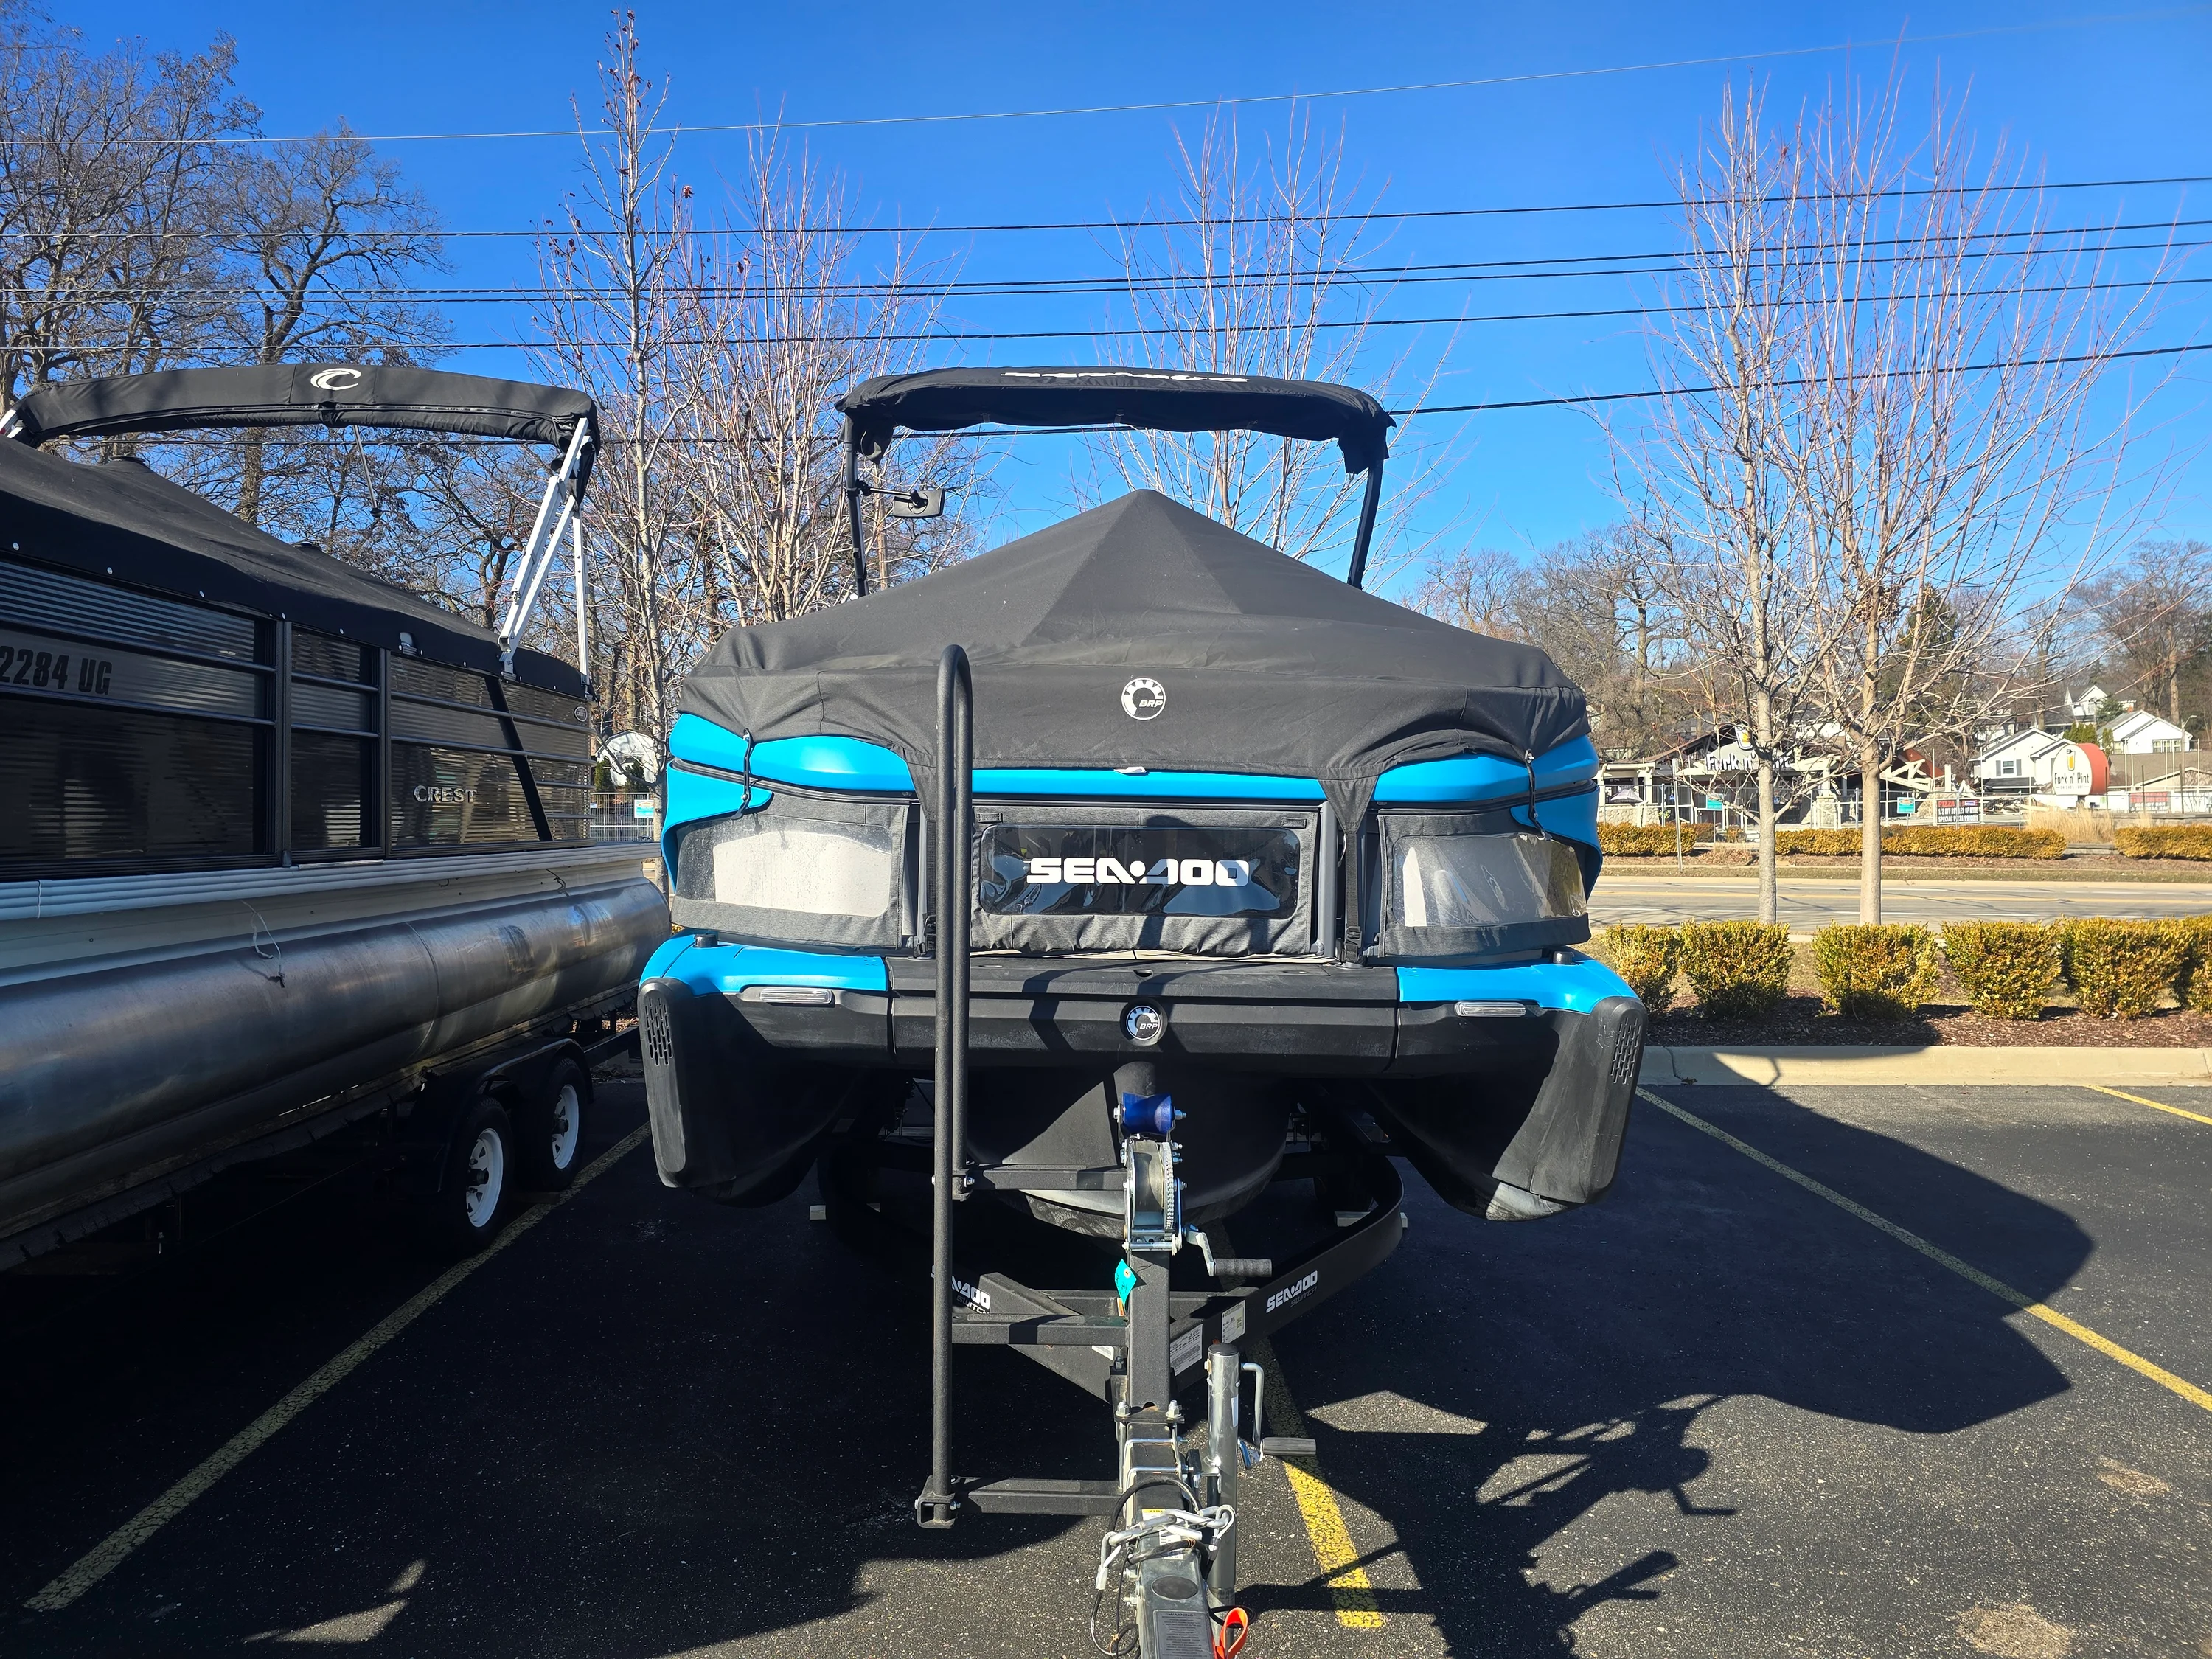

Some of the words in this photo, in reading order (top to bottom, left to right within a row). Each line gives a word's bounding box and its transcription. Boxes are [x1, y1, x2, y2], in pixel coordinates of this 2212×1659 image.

[0, 645, 69, 689] 2284
[78, 658, 112, 695] UG
[1706, 752, 1739, 771] Fork
[2054, 773, 2067, 784] Fork
[2077, 772, 2090, 783] Pint
[413, 785, 477, 803] CREST
